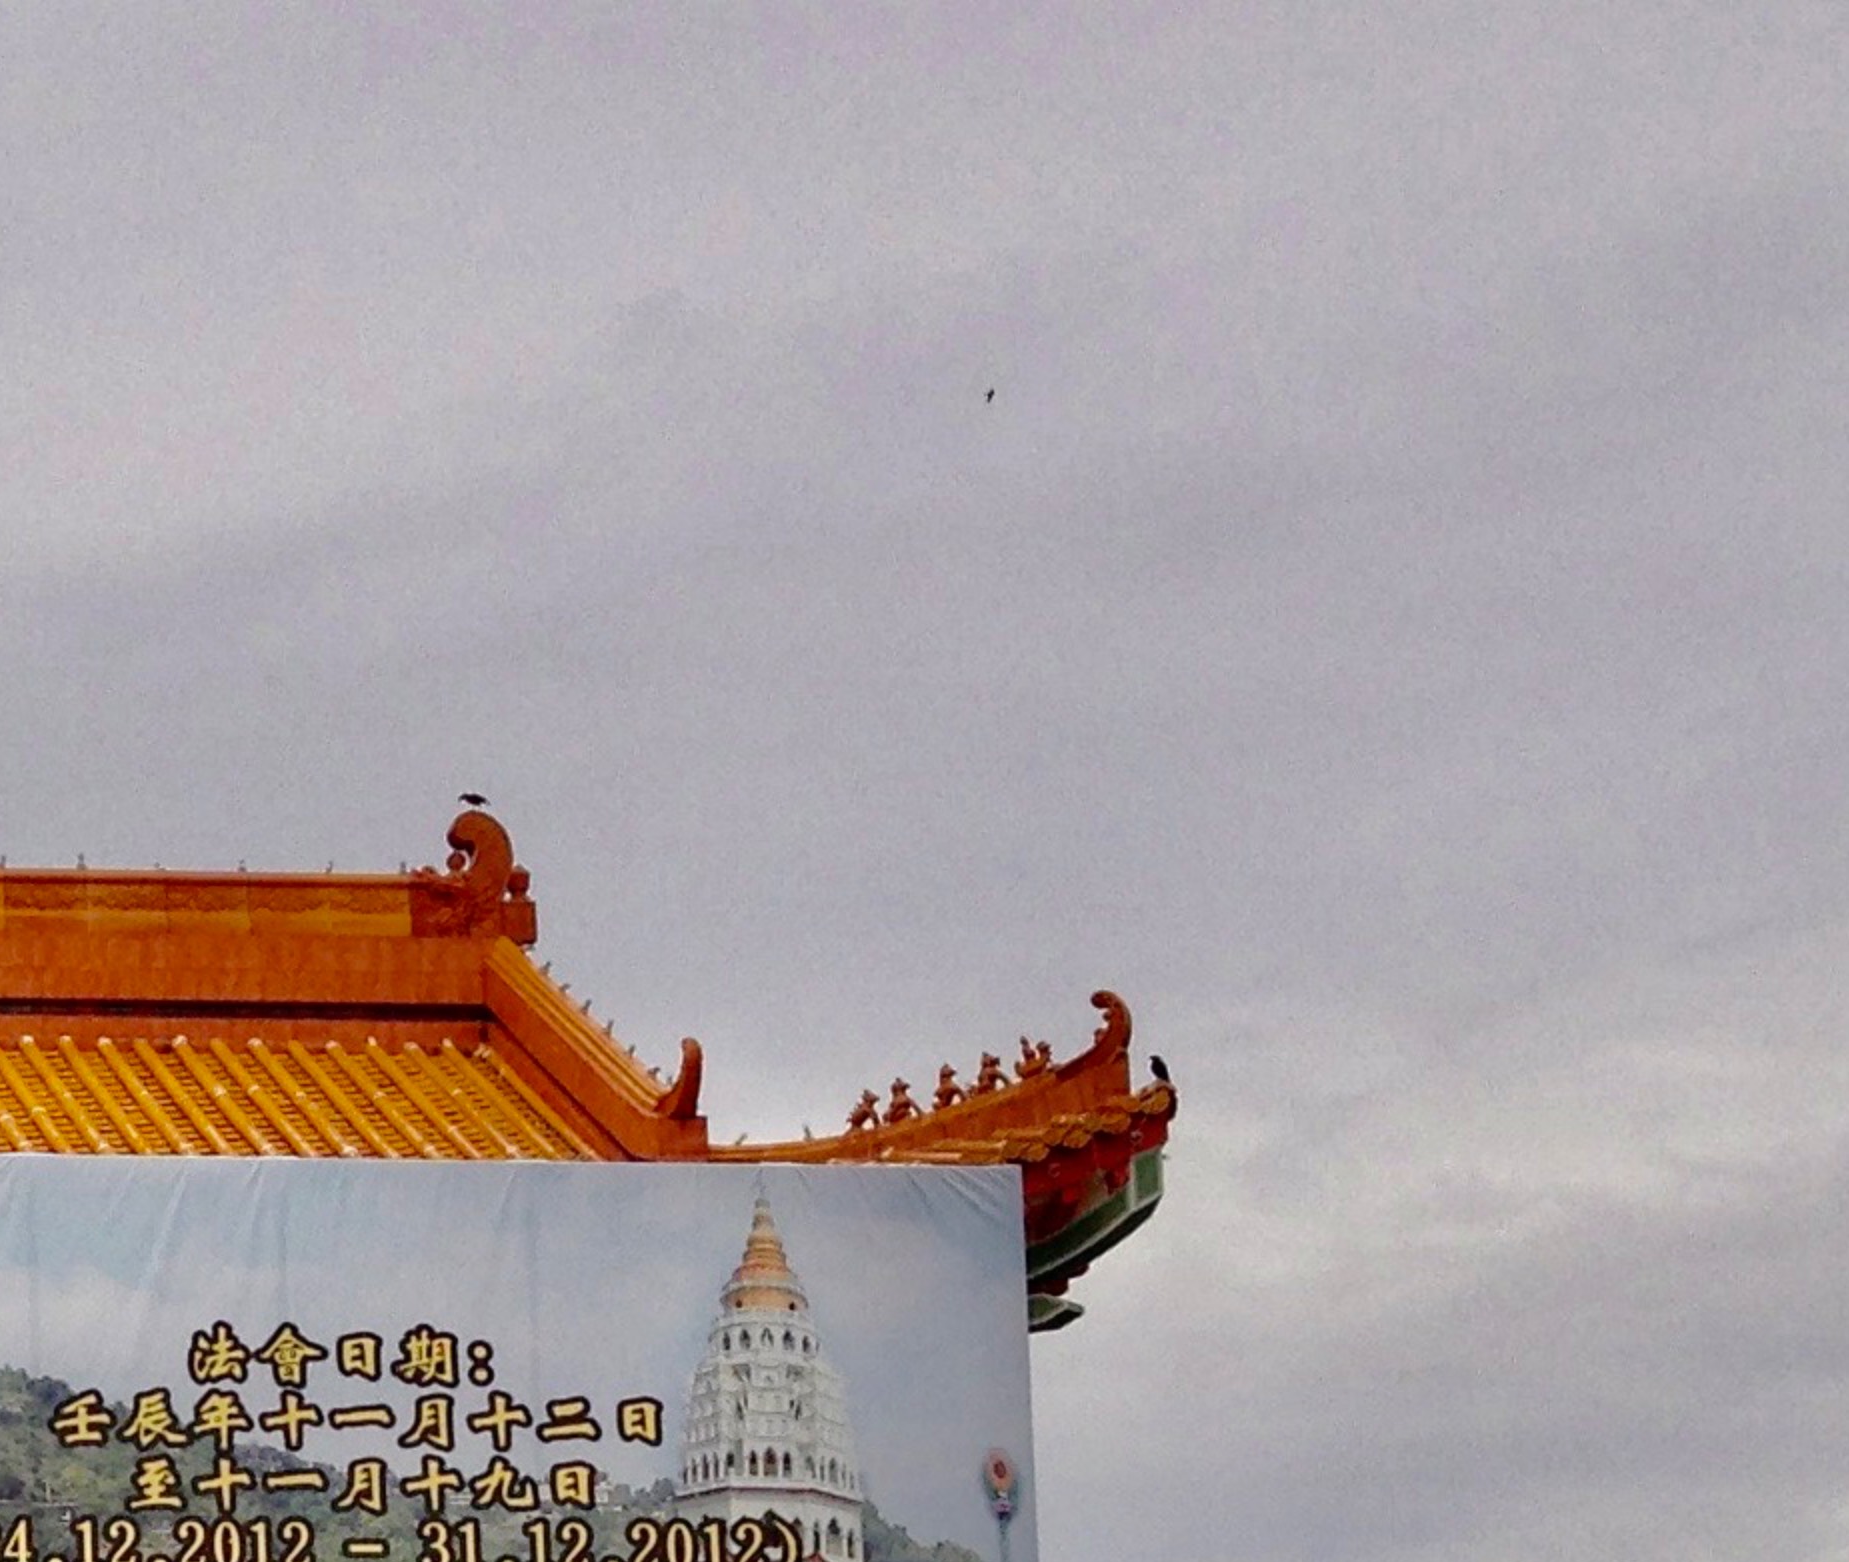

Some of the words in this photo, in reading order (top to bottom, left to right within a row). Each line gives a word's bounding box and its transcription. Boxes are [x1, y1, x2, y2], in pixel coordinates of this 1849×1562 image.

[192, 1325, 495, 1386] 法會日期：
[52, 1396, 664, 1448] 壬辰年十一月十二日
[130, 1460, 595, 1512] 至十一月十九日
